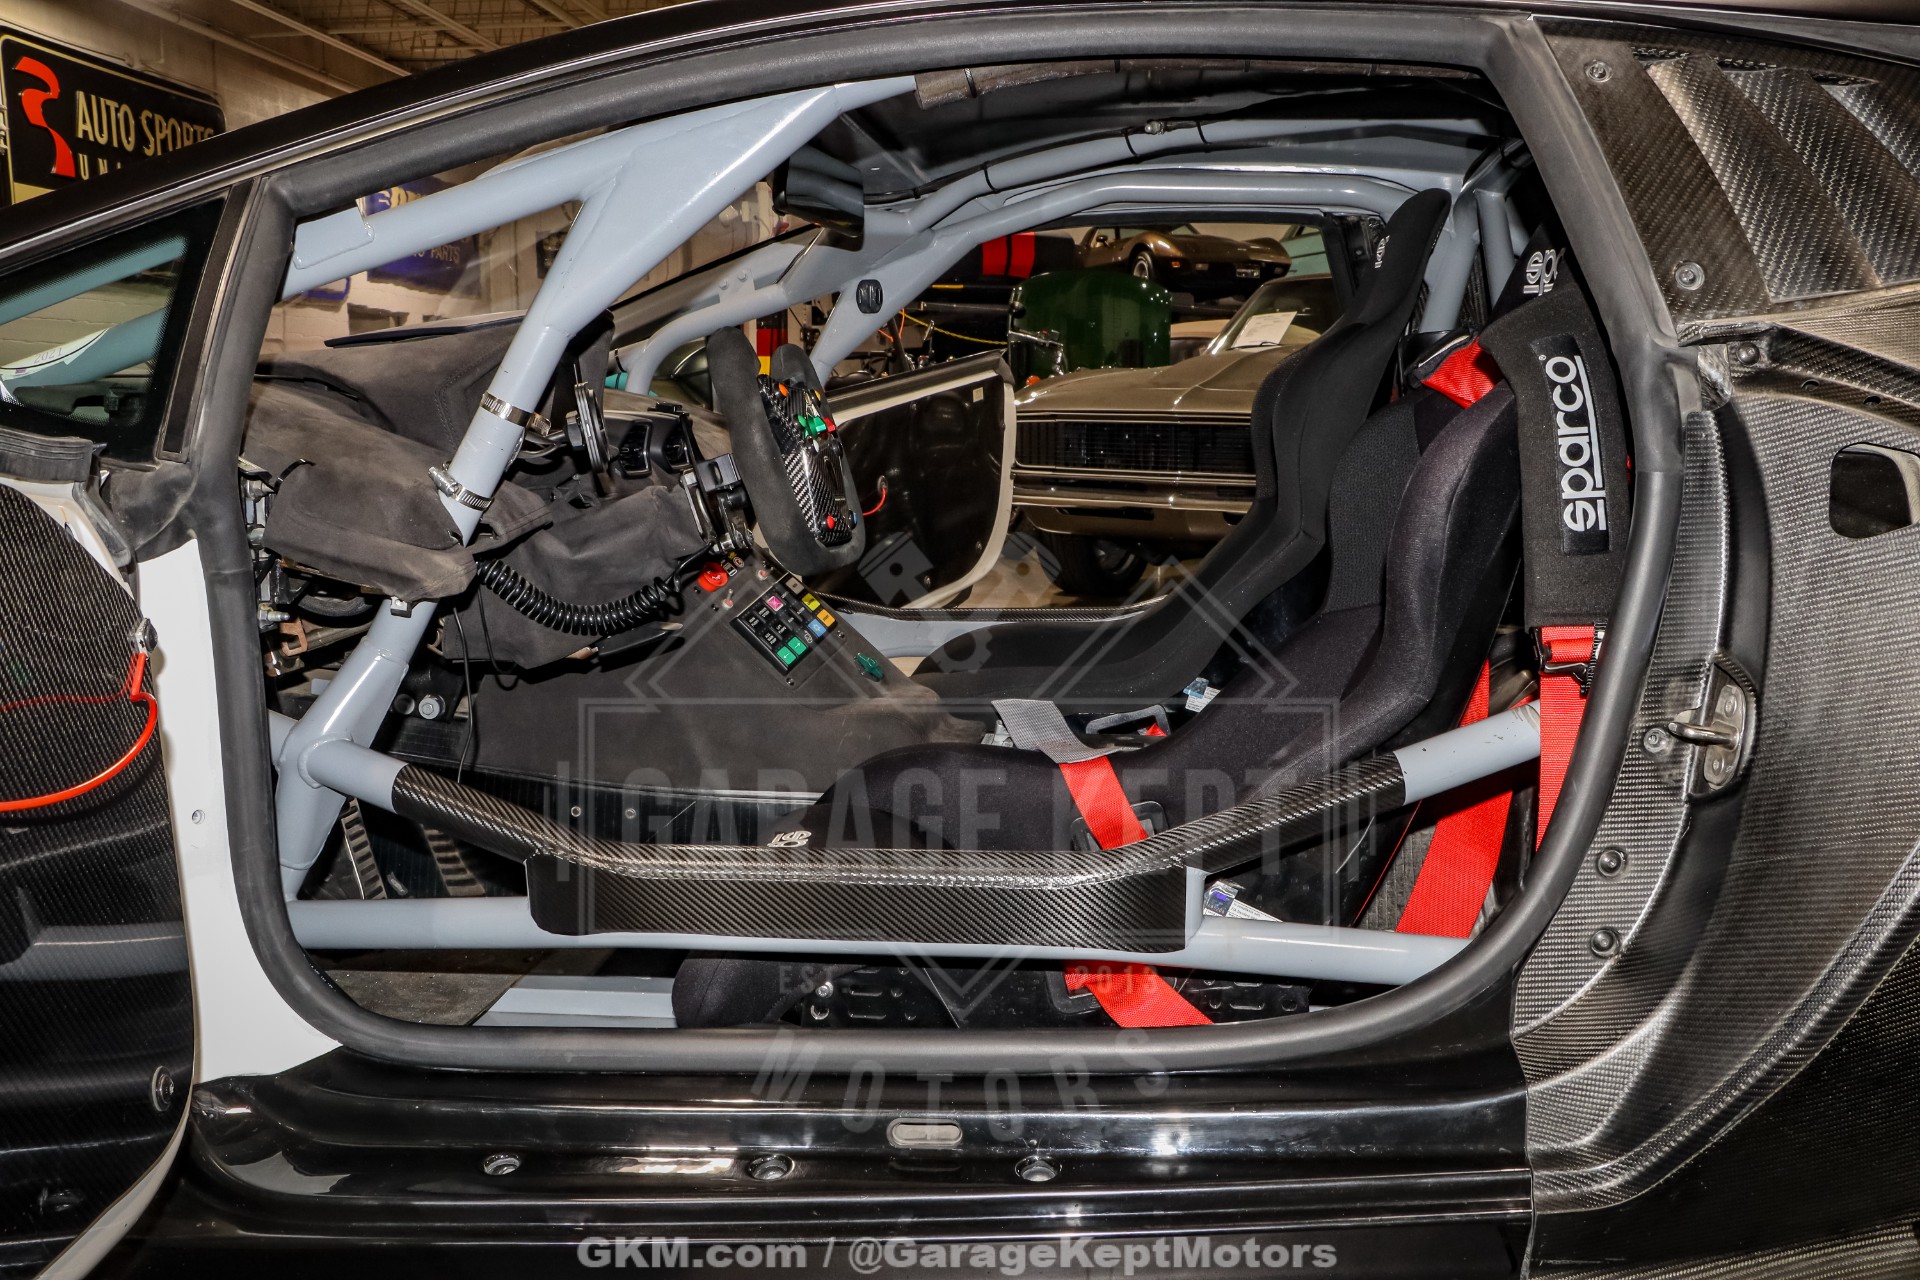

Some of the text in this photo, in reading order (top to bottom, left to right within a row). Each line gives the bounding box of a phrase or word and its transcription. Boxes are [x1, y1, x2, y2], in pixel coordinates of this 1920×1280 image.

[76, 90, 135, 152] AUTO
[430, 243, 461, 265] PARTS
[1545, 355, 1607, 532] sparco
